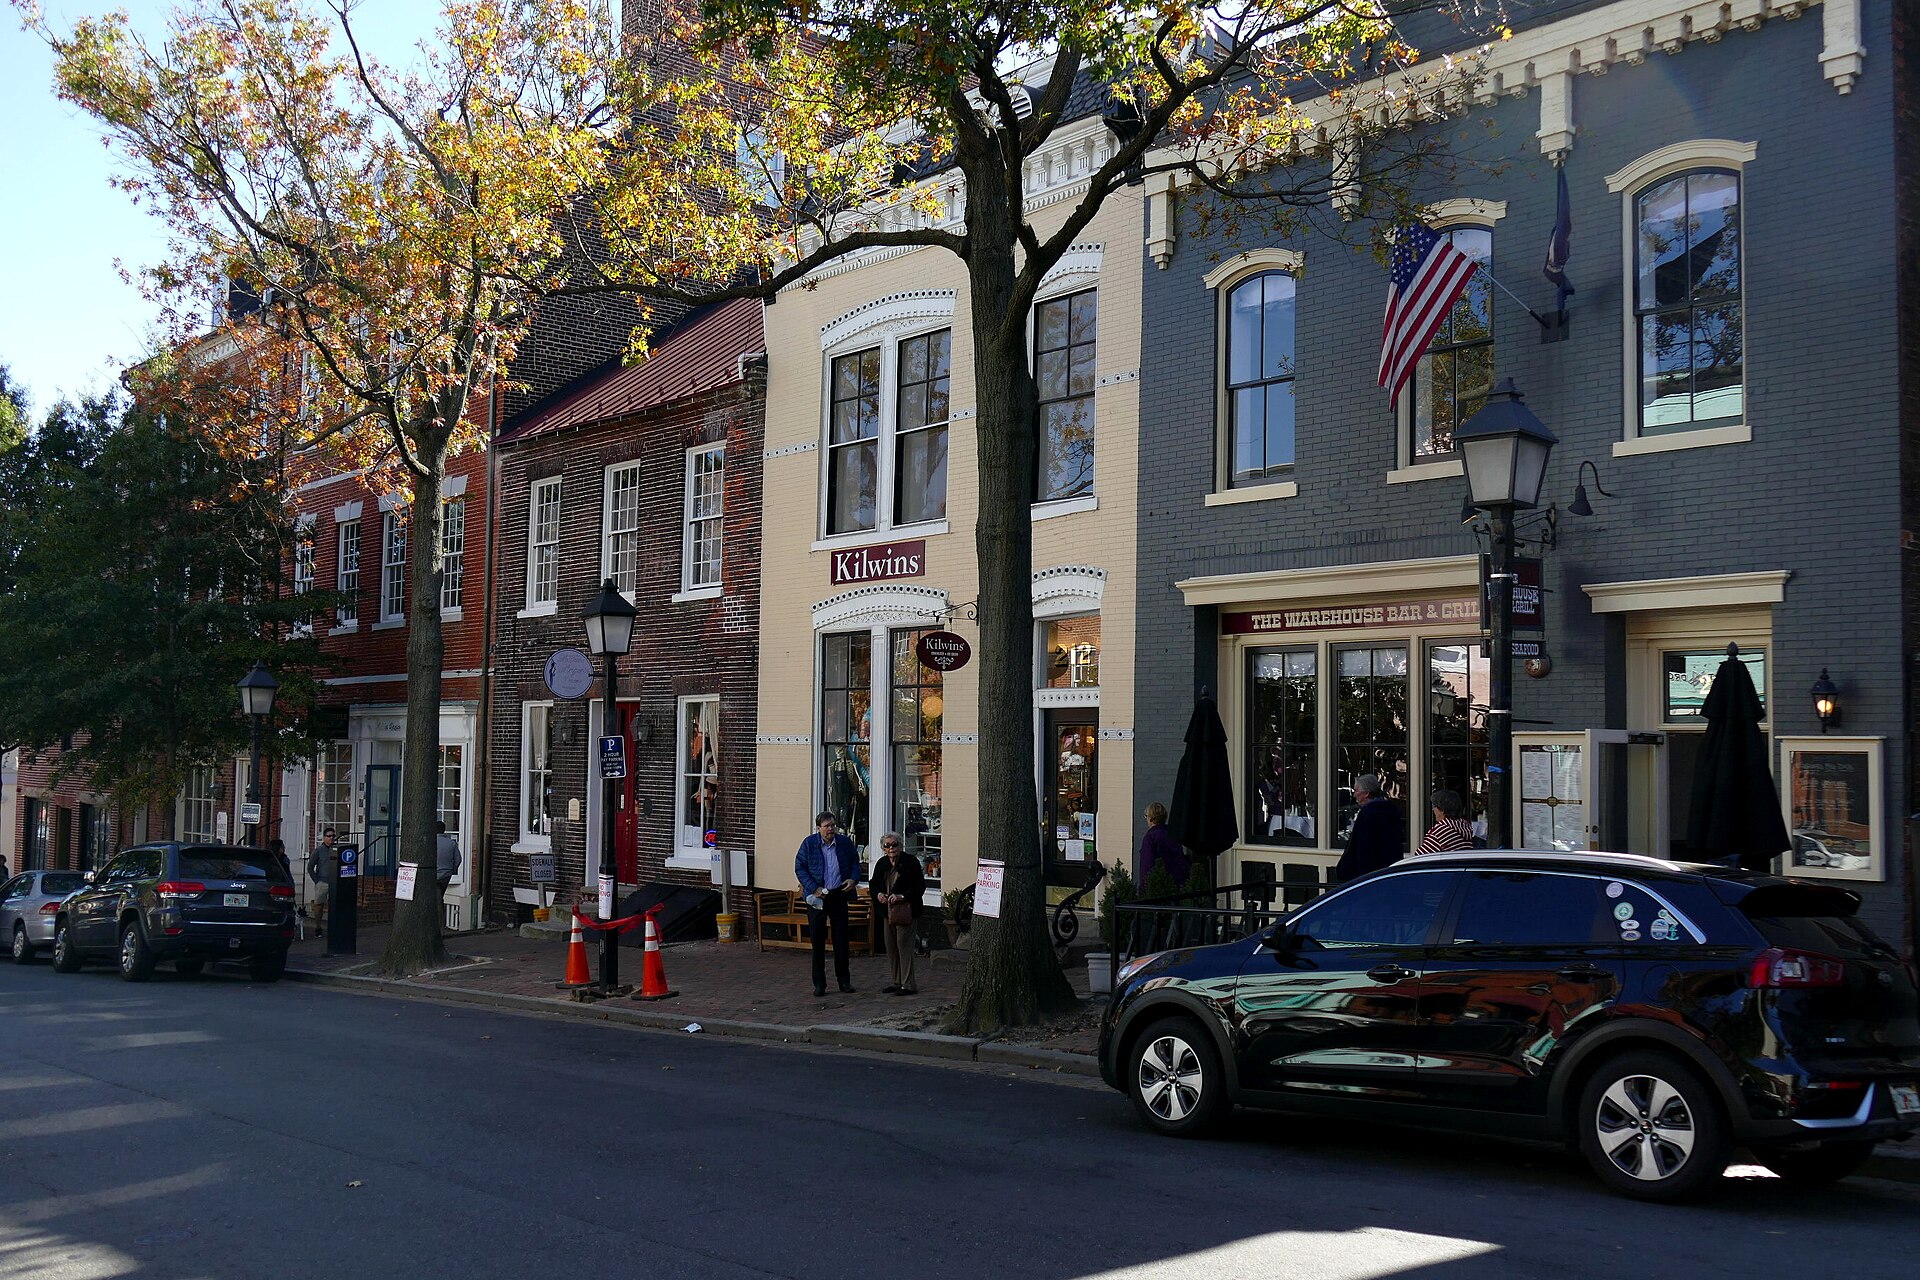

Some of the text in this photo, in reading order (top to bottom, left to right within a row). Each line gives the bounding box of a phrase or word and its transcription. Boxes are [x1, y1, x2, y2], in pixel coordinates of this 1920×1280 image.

[835, 547, 920, 582] Kilwins
[1251, 601, 1480, 630] THE WAREHOUSE BAR & GRIL
[925, 637, 965, 651] Kilwins
[1512, 642, 1539, 655] SEAFOOD
[607, 739, 615, 751] P
[346, 851, 353, 861] P
[531, 858, 554, 866] SIDEWALK
[535, 870, 553, 878] CLOSED
[983, 873, 992, 881] NO
[976, 879, 1001, 890] PARKING
